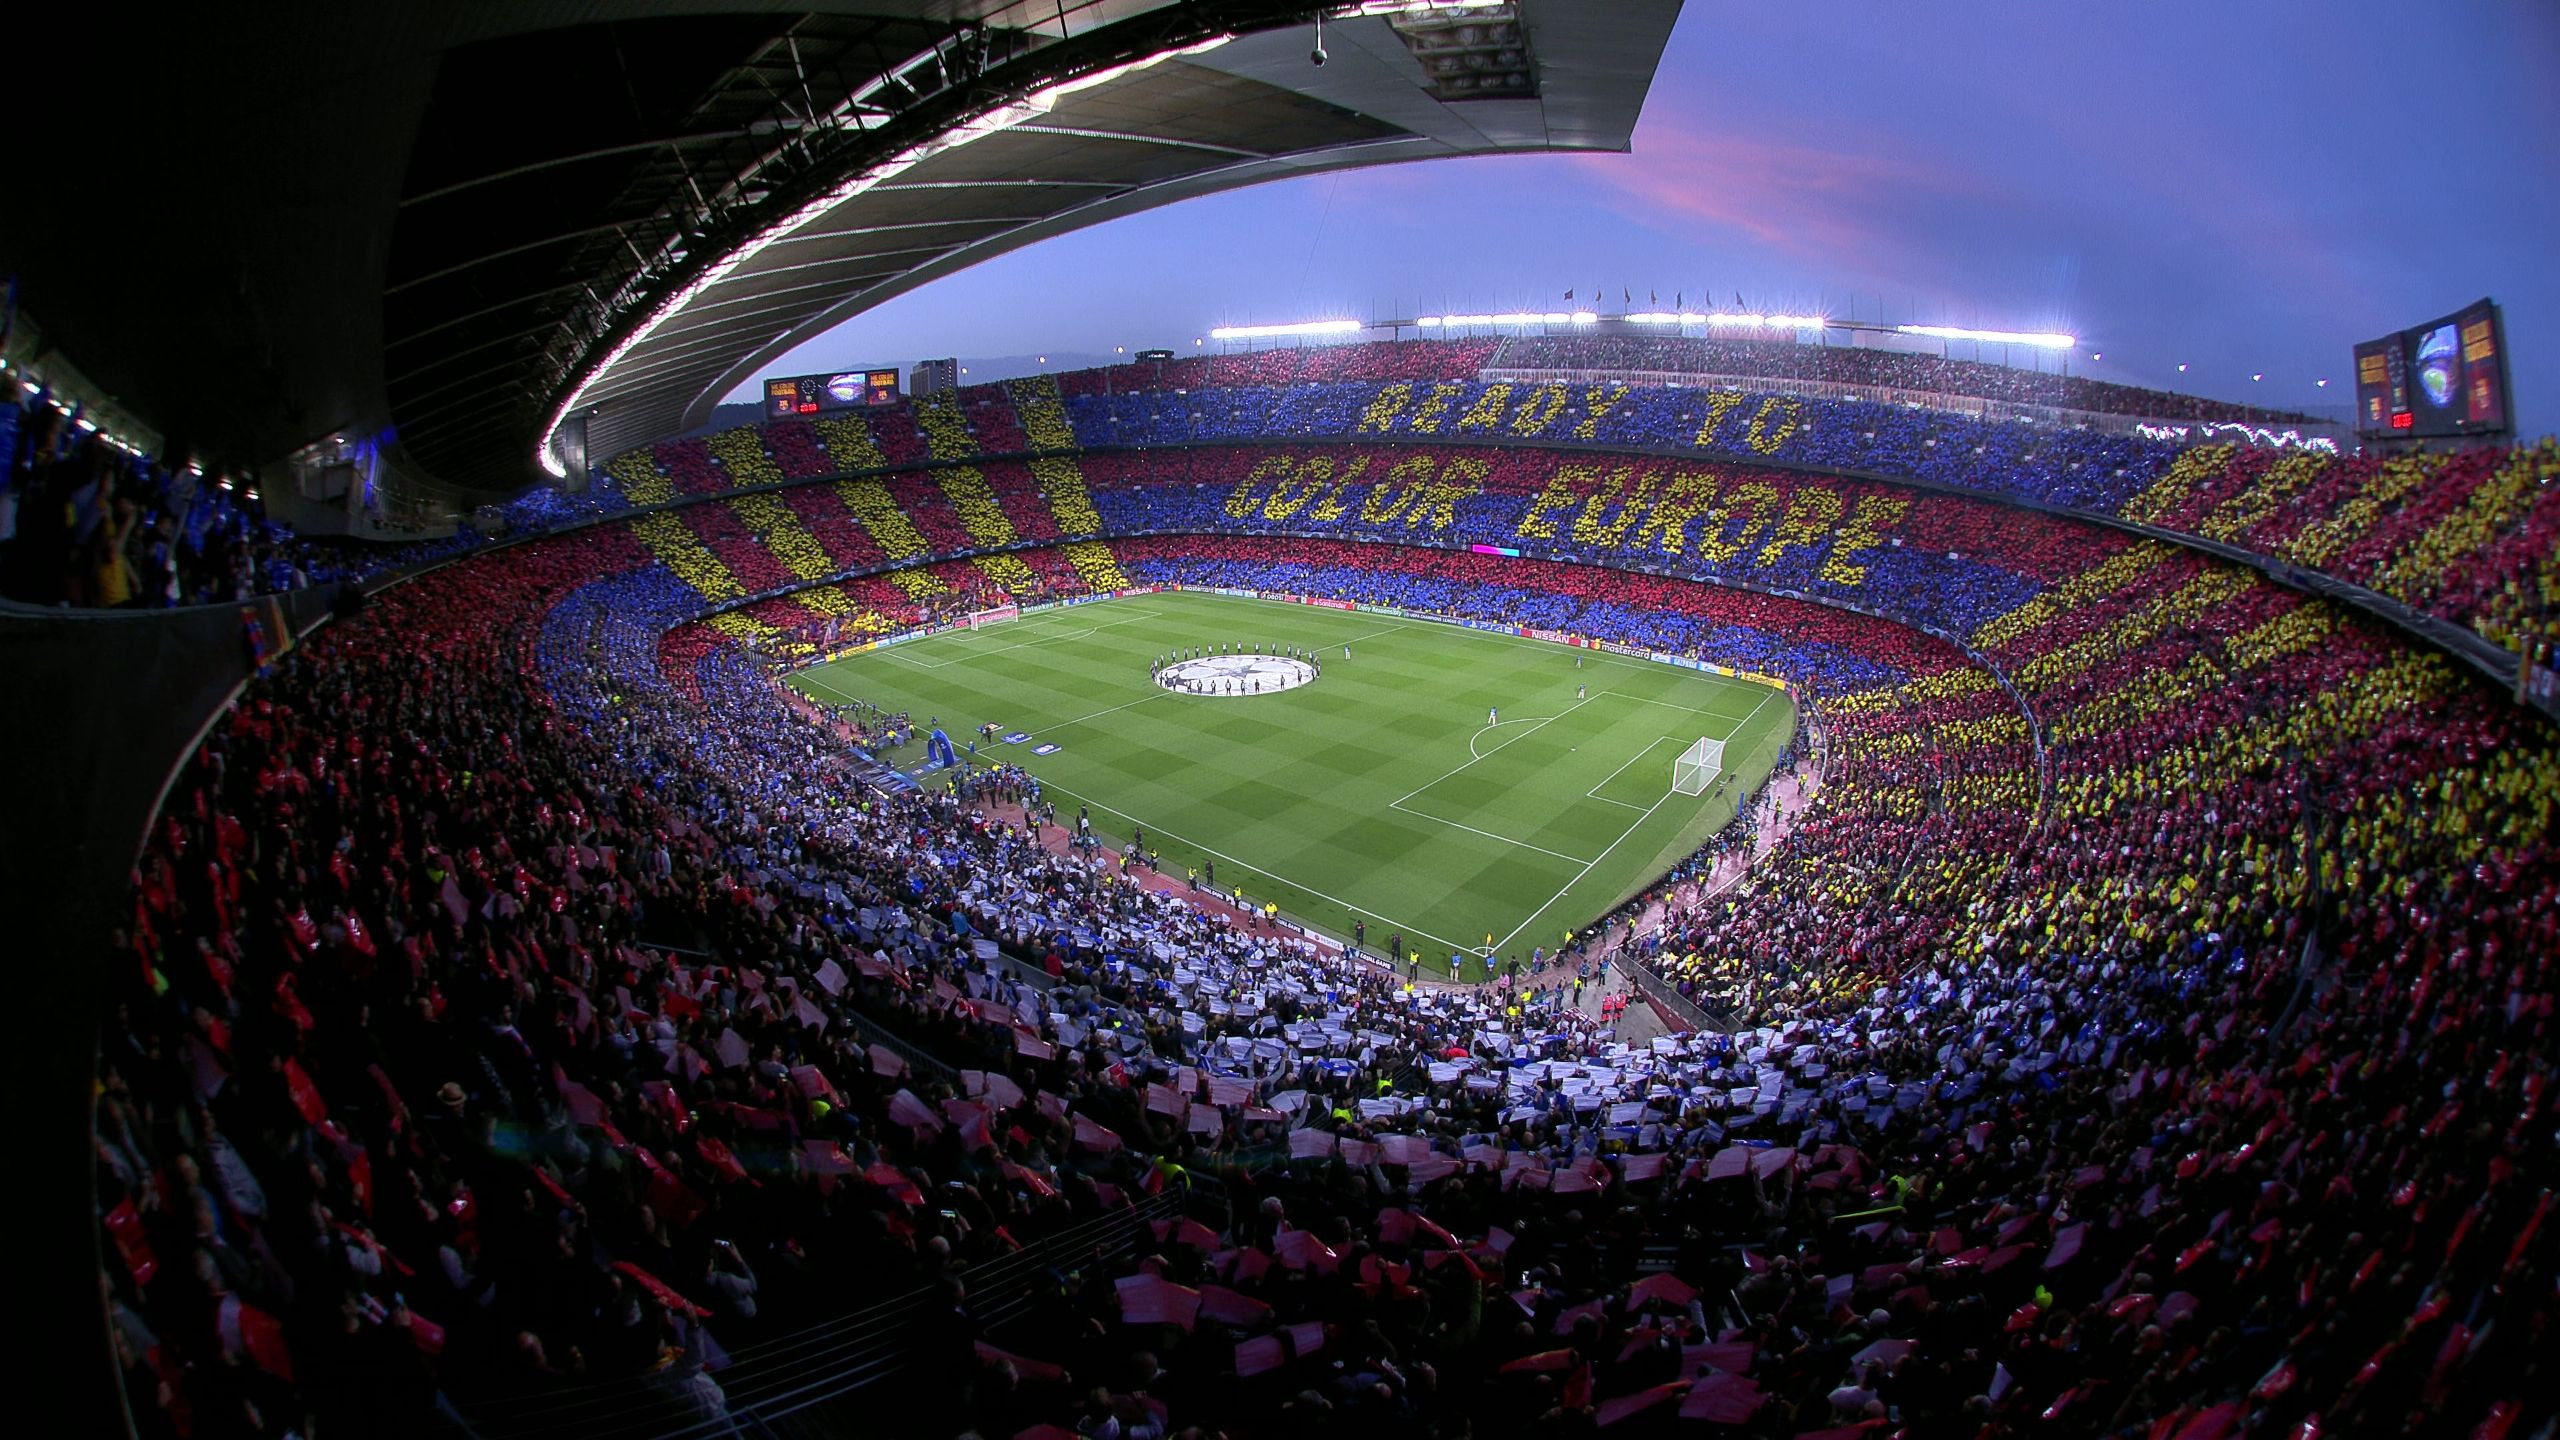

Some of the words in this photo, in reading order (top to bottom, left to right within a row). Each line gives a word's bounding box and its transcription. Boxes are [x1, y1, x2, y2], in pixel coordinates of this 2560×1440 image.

[1358, 384, 1629, 440] READY
[1695, 391, 1801, 455] TO
[1224, 455, 1489, 532] COLOR
[1516, 464, 1909, 586] EUROPE
[1123, 587, 1153, 597] NISSAN
[1023, 602, 1054, 613] Heineken
[1319, 598, 1347, 609] Santander
[985, 610, 1014, 621] Santander
[935, 620, 954, 633] pepsi
[1480, 623, 1503, 633] PS4
[1531, 630, 1569, 644] NISSAN
[1602, 644, 1650, 659] mastercard
[1360, 953, 1376, 963] EQUAL
[1375, 959, 1391, 969] GAME
